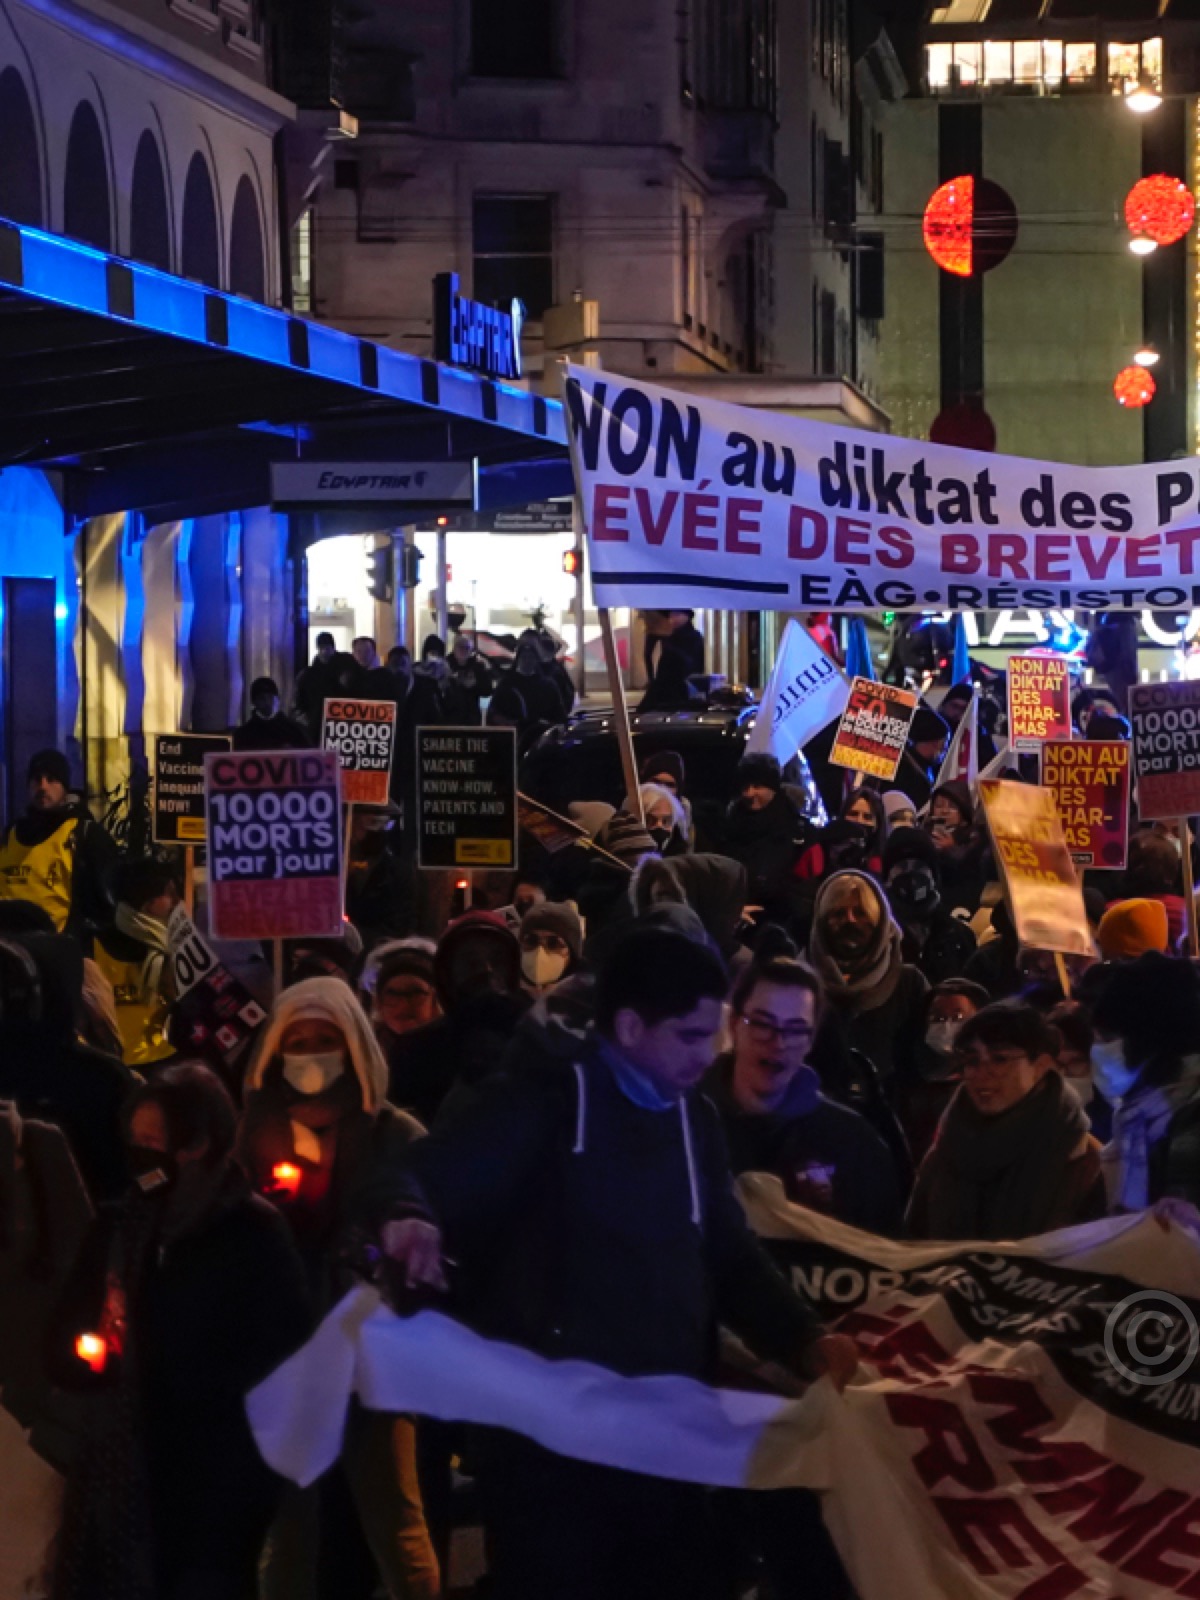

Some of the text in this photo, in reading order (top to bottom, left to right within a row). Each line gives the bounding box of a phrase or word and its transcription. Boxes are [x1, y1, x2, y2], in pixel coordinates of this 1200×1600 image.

[566, 377, 701, 480] NON
[721, 431, 797, 496] au
[818, 440, 999, 526] diktat
[1020, 473, 1134, 533] des
[592, 478, 763, 555] EVÉE
[787, 504, 915, 569] DES
[1009, 659, 1066, 676] NON AU
[1010, 675, 1063, 692] DIKTAT
[1011, 689, 1041, 706] DES
[328, 701, 393, 720] COVID:
[1012, 705, 1061, 723] PHAR-
[1013, 721, 1048, 737] MAS
[159, 741, 182, 755] End
[325, 738, 389, 756] MORTS
[422, 737, 489, 753] SHARE THE
[340, 754, 388, 771] ar jour
[1044, 745, 1092, 765] NON
[1097, 746, 1128, 766] AU
[211, 756, 335, 786] COVID:
[422, 759, 476, 773] VACCINE
[1137, 756, 1173, 777] par
[1044, 766, 1121, 786] DIKTAT
[159, 799, 191, 813] NOW!
[209, 791, 334, 823] 10000
[423, 801, 505, 815] PATENTS AND
[1059, 808, 1113, 827] HAR-
[213, 822, 334, 851] MORTS
[424, 821, 456, 835] TECH
[1066, 828, 1091, 847] AS
[215, 848, 334, 880] par jour
